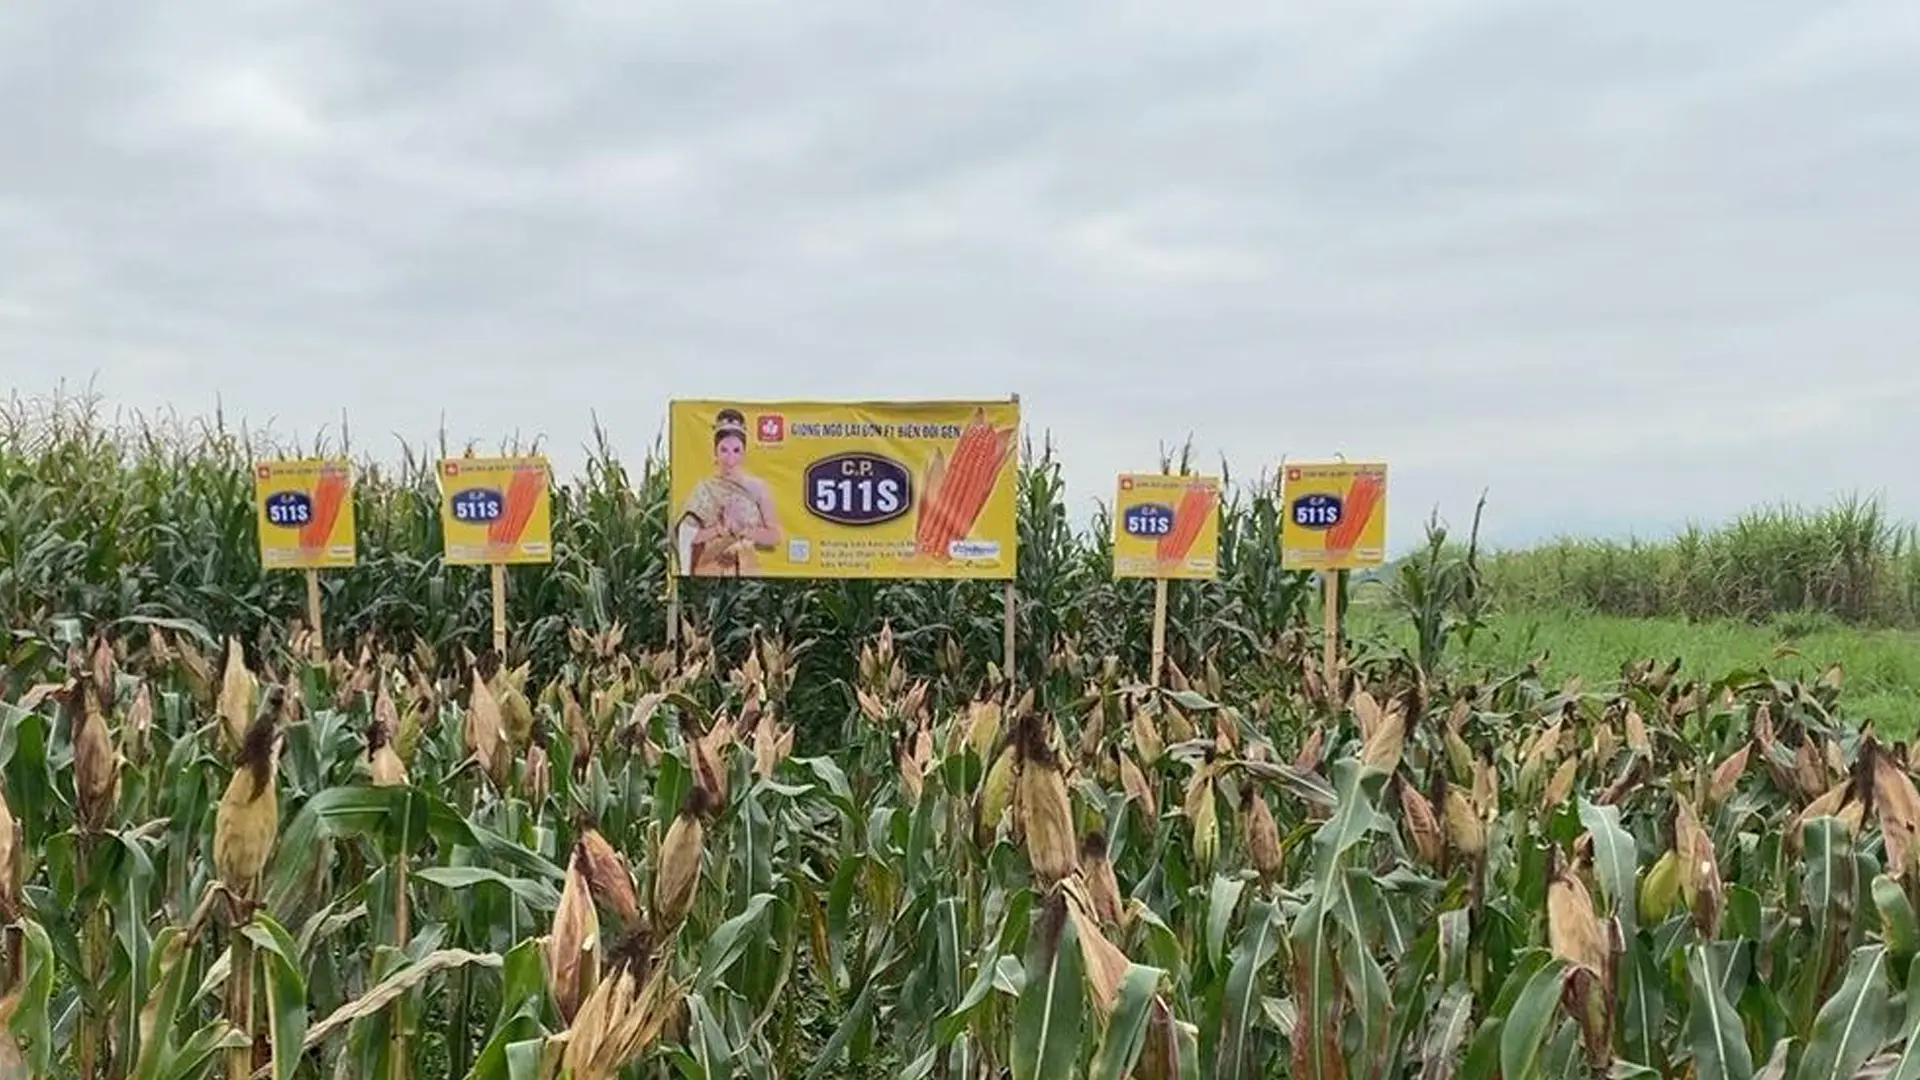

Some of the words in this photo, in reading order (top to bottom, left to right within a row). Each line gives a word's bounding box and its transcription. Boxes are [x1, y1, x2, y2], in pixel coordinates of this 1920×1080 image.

[841, 460, 874, 476] C.P.
[816, 479, 899, 512] 511S
[269, 504, 308, 521] 511S
[456, 501, 499, 518] 511S
[1296, 506, 1338, 523] 511S
[1127, 516, 1169, 533] 511S
